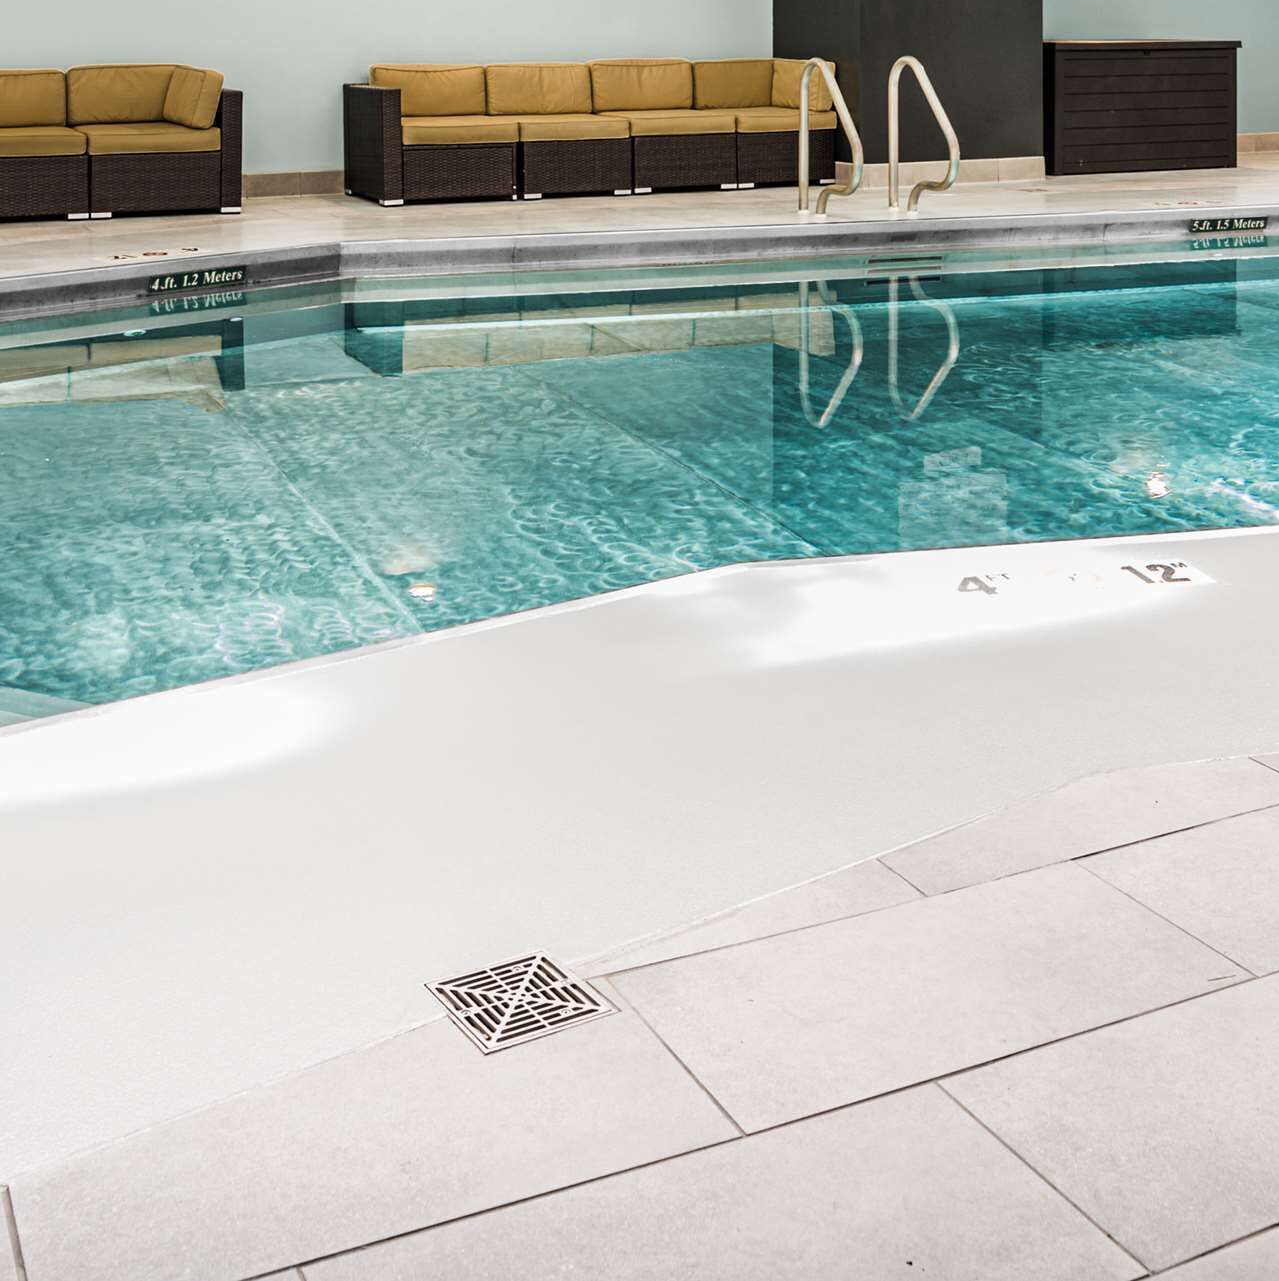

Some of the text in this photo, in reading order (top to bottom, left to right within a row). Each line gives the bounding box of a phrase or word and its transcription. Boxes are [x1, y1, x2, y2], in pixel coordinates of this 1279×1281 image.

[1192, 221, 1199, 230] 5
[1216, 220, 1230, 230] 1.5
[1233, 219, 1264, 229] Meters
[152, 278, 159, 290] 4
[182, 274, 198, 287] 1.2
[203, 270, 243, 284] Meters
[957, 575, 999, 595] 4
